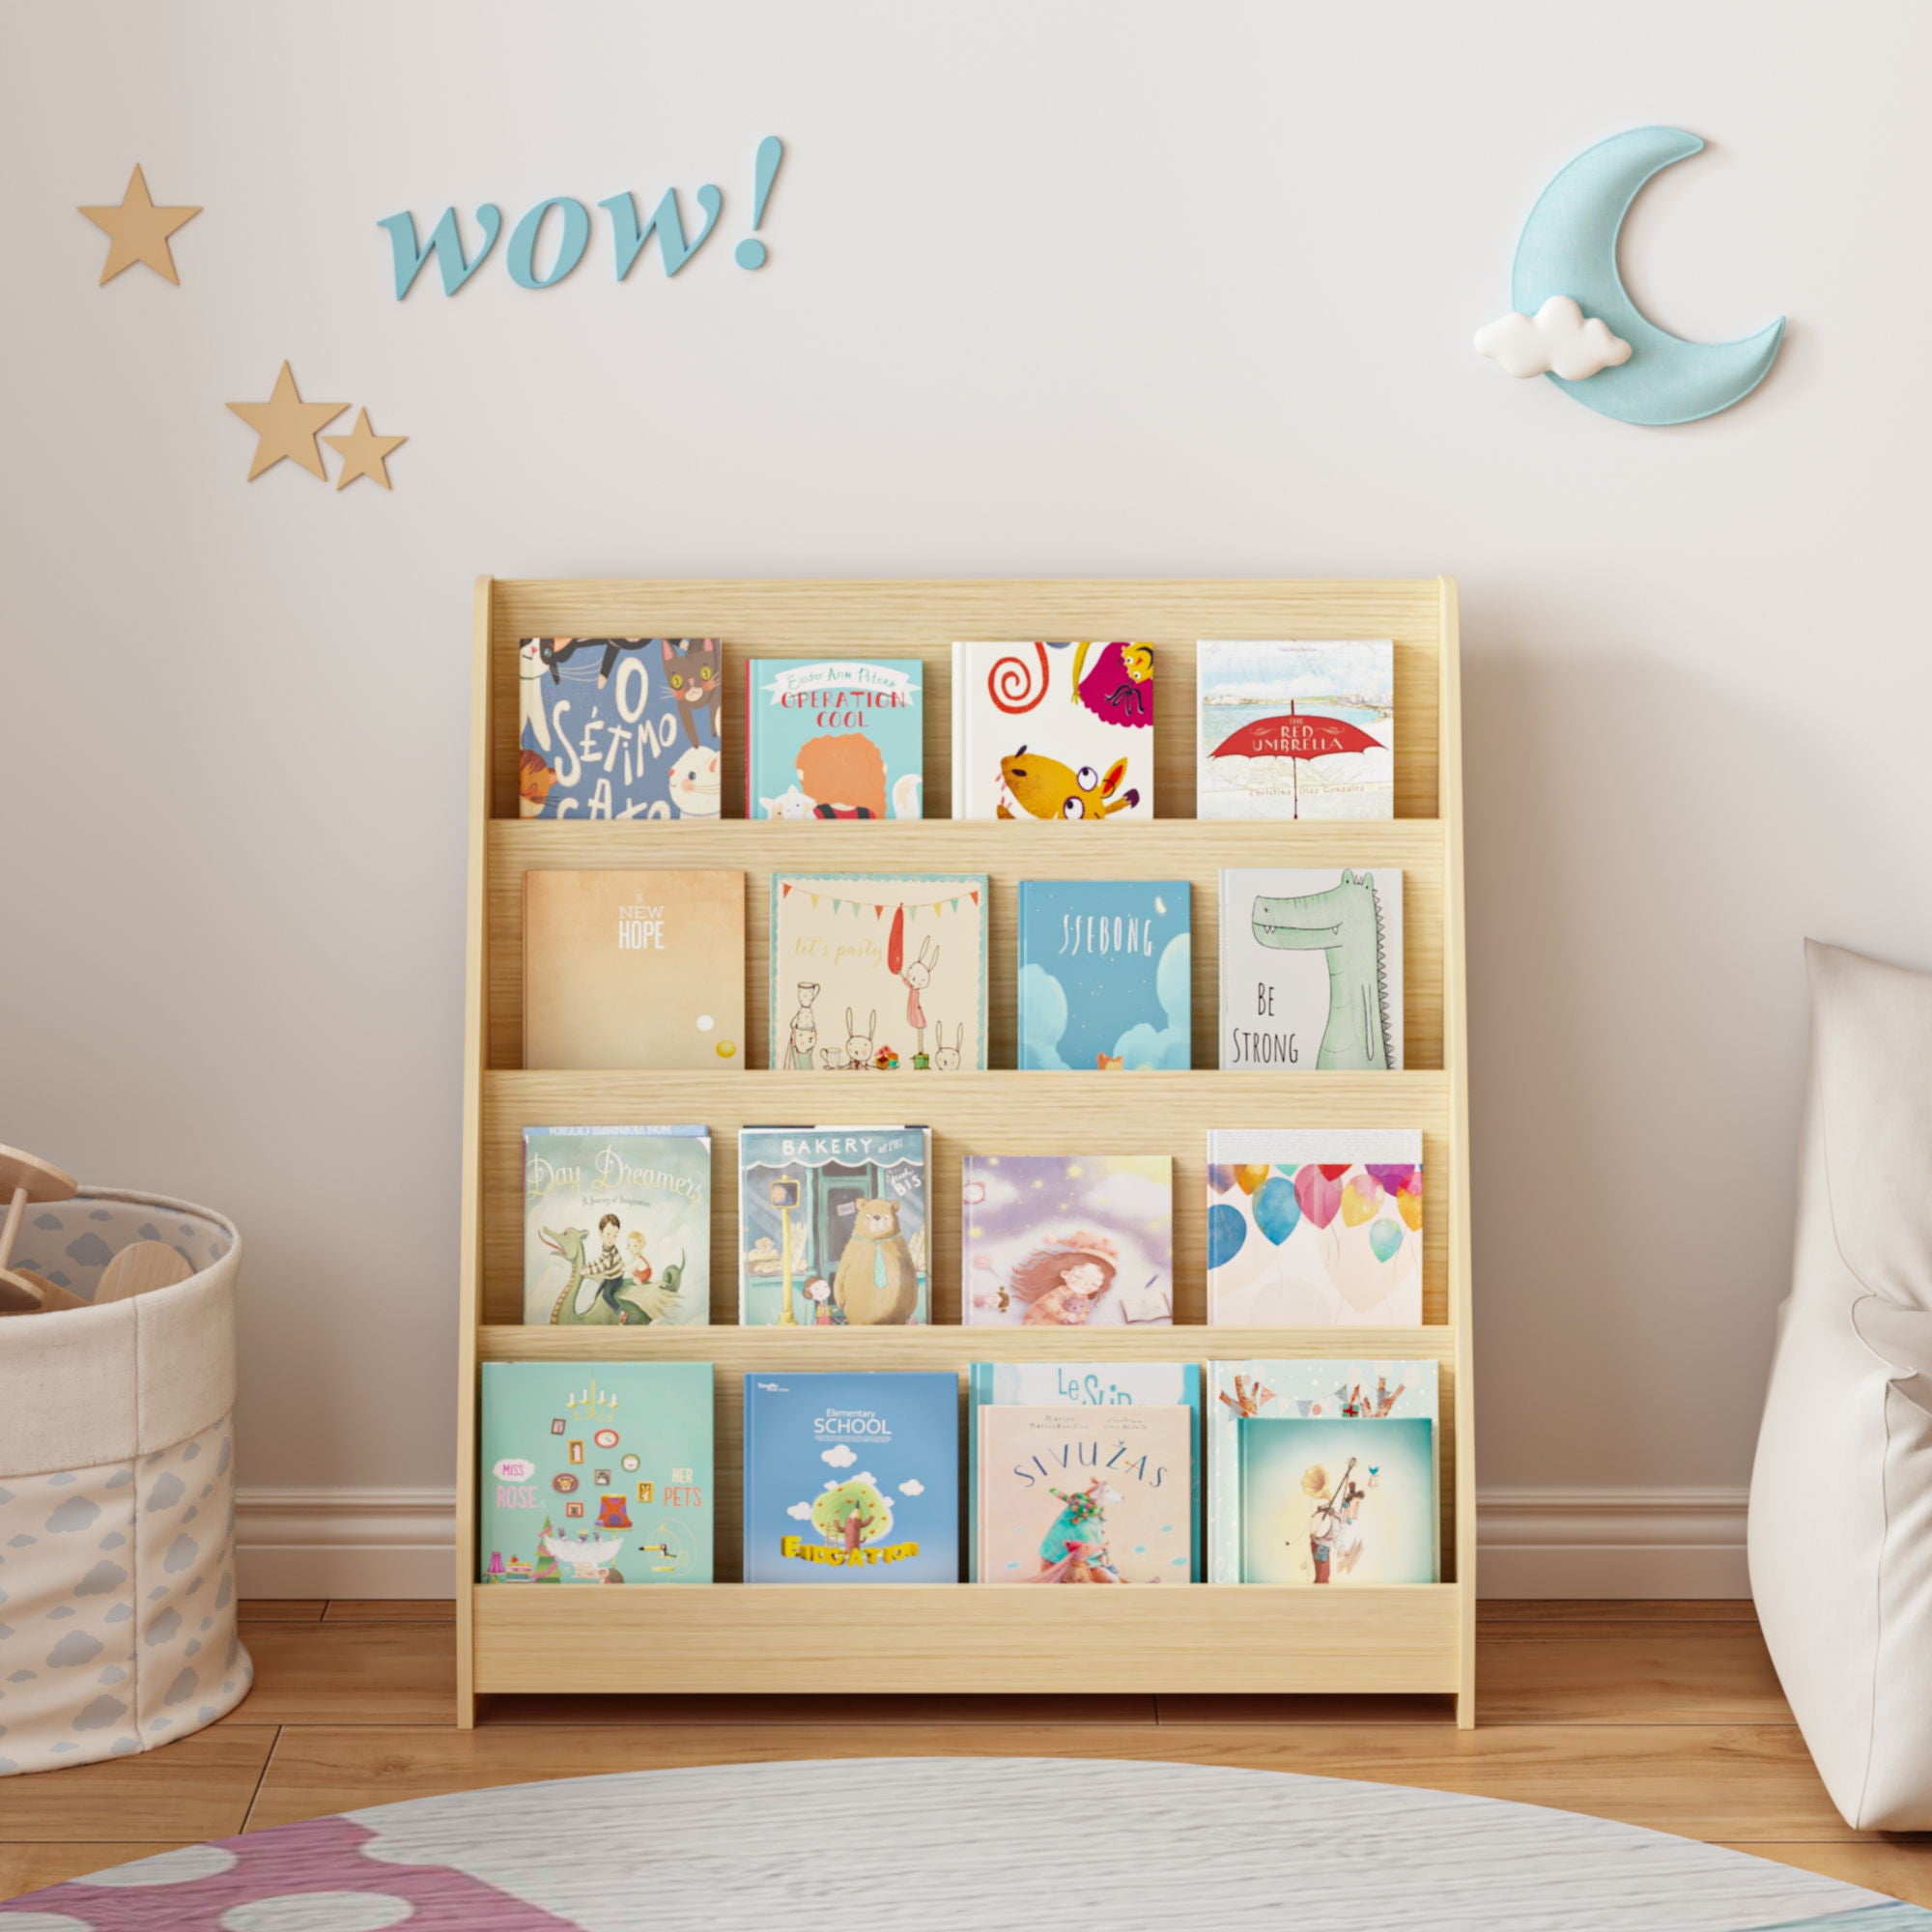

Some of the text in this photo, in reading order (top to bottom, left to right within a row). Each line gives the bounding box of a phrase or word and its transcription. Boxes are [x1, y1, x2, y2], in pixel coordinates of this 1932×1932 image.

[376, 134, 786, 302] wow!
[615, 657, 649, 724] O
[781, 691, 905, 709] OPERATION
[816, 711, 869, 728] COOL
[1281, 725, 1314, 739] RED
[553, 699, 677, 788] SÉTIMO
[1252, 738, 1344, 753] UMBRELLA
[618, 904, 666, 920] NEW
[618, 921, 666, 950] HOPE
[782, 1138, 873, 1156] BAKERY
[526, 1144, 704, 1205] Day Dreamers
[1058, 1367, 1079, 1402] Le
[826, 1407, 876, 1419] Elementary
[813, 1418, 893, 1435] SCHOOL
[502, 1464, 525, 1477] MISS
[1014, 1440, 1168, 1489] SIVUŽAS
[671, 1467, 694, 1484] HER
[496, 1486, 538, 1509] ROSE
[664, 1487, 702, 1507] PETS
